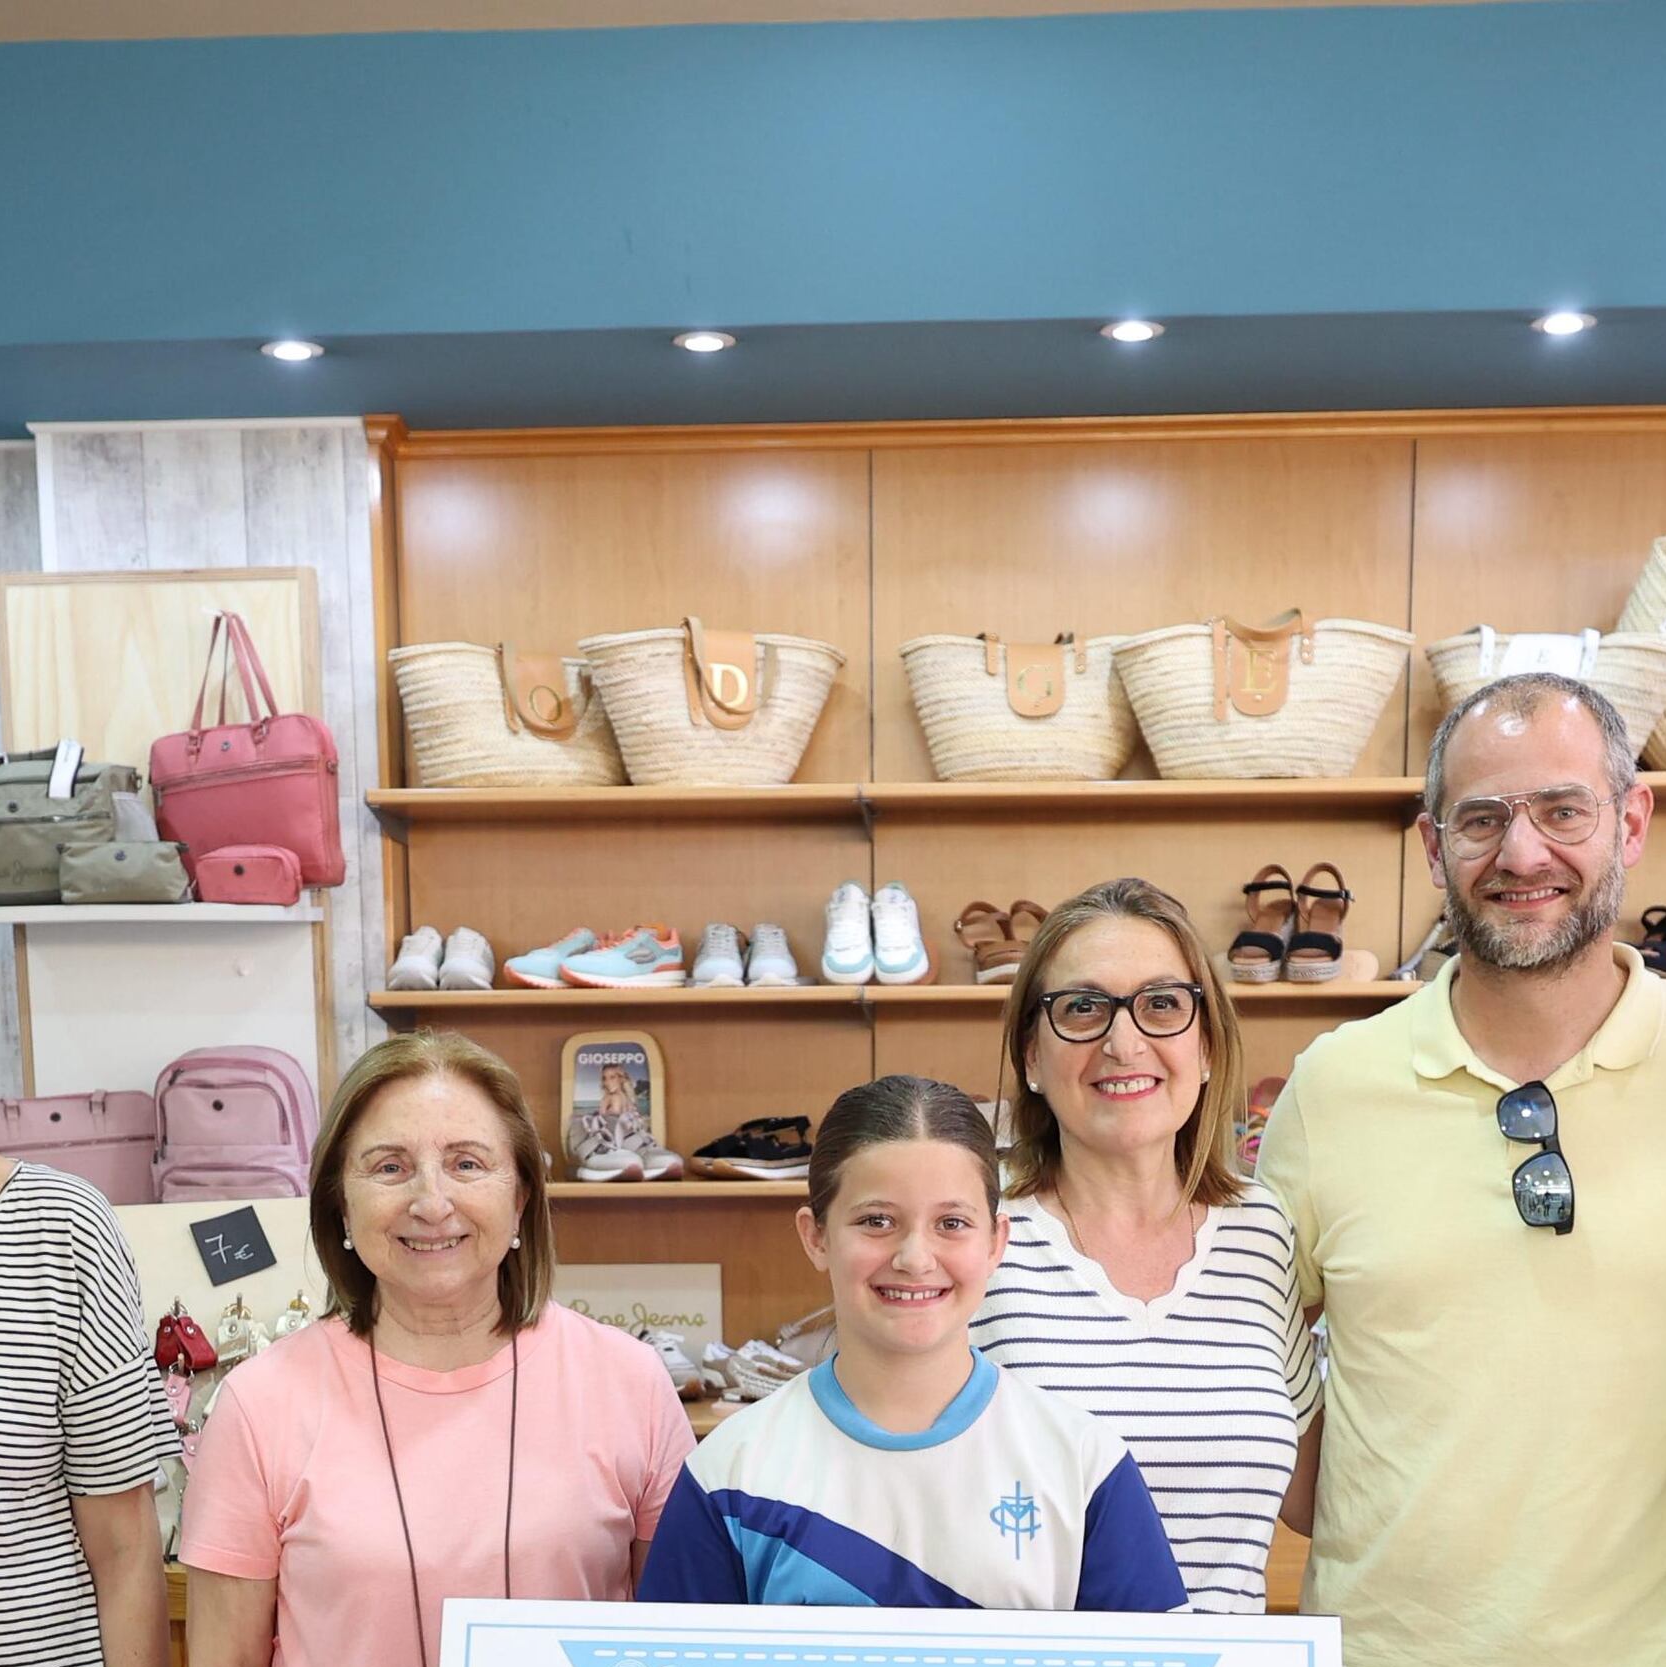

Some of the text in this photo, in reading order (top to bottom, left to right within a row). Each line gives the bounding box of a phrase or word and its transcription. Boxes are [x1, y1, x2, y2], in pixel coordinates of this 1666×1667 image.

[709, 662, 749, 709] D
[577, 1052, 646, 1065] GIOSEPPO
[204, 1233, 233, 1265] 7
